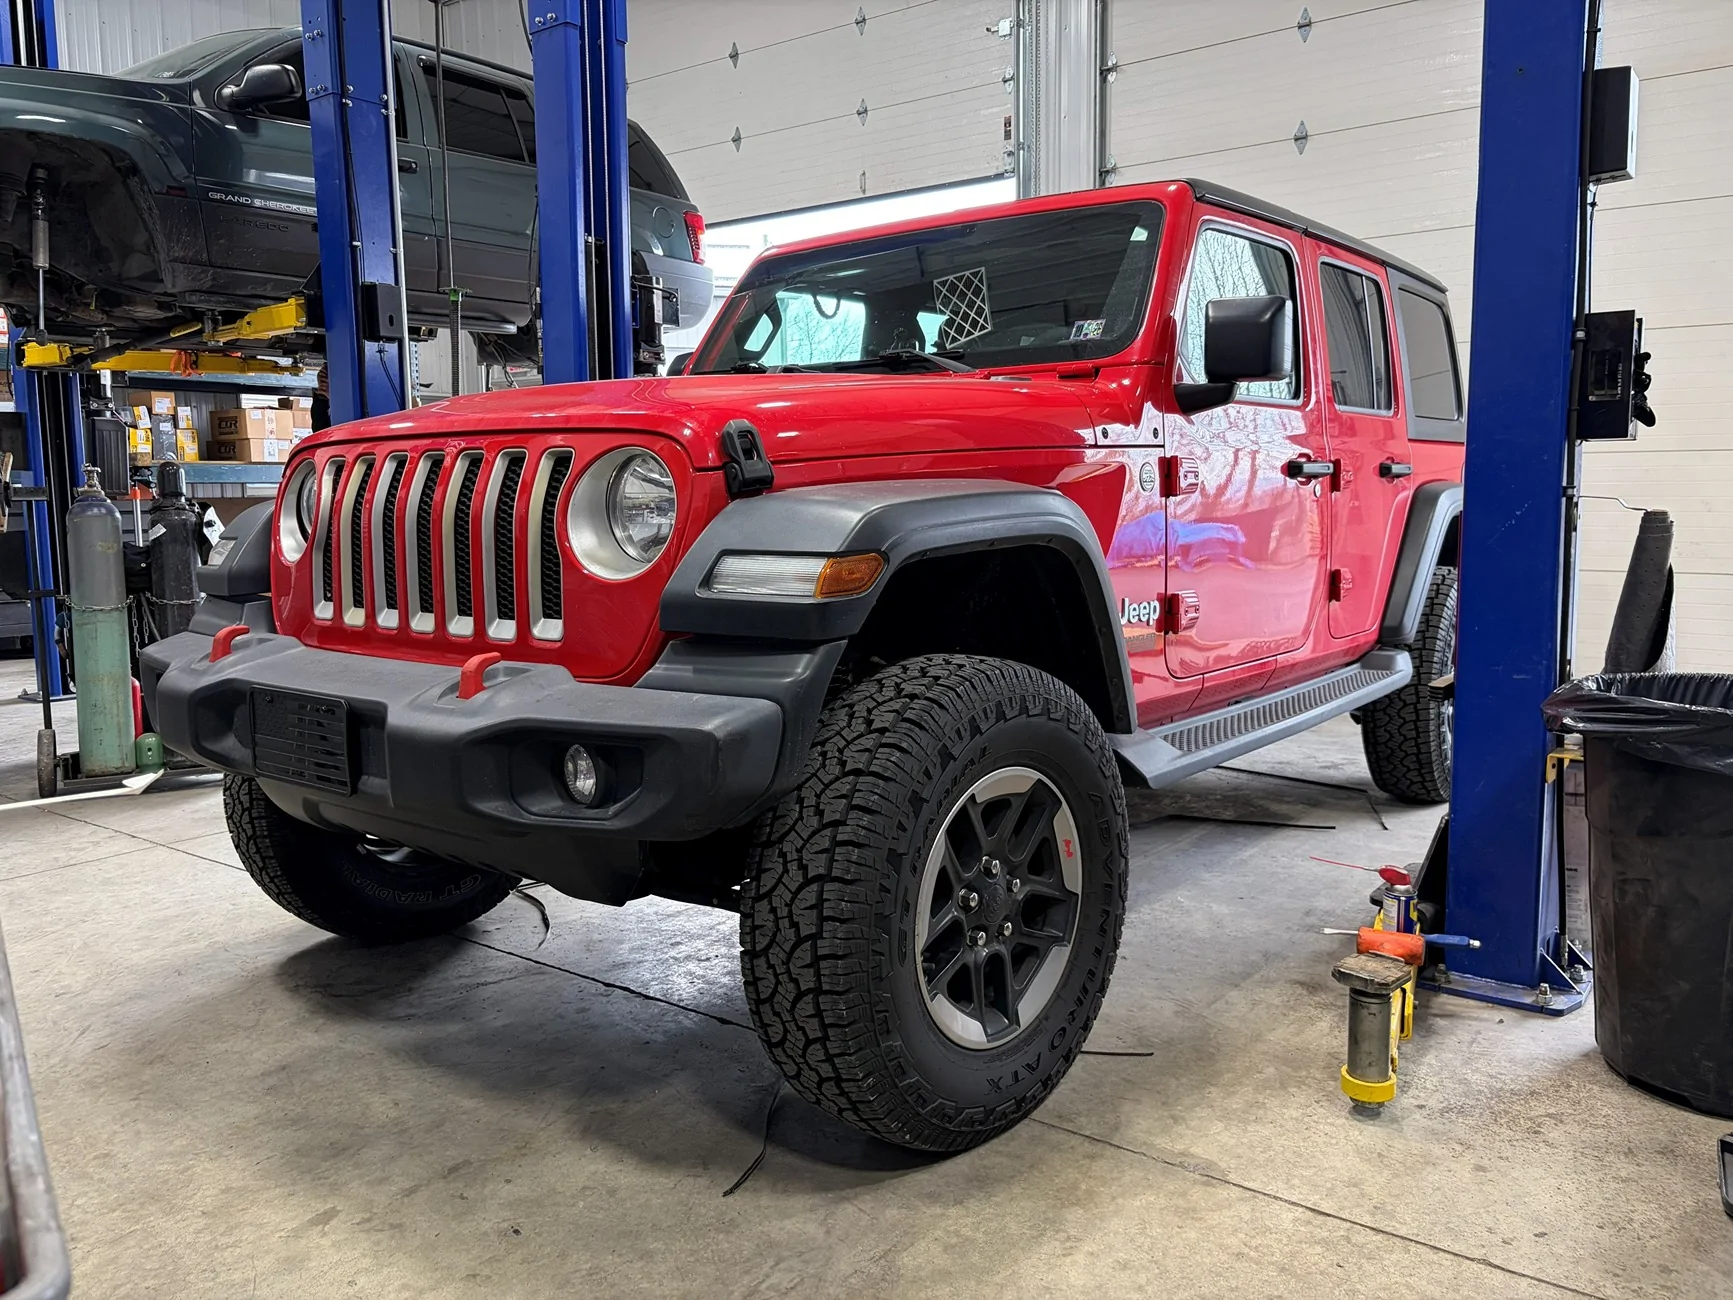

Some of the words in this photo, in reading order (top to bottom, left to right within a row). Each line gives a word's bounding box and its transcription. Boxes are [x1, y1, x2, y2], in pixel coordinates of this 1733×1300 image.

[208, 191, 252, 204] GRAND
[253, 198, 315, 214] CHEROKEE
[220, 215, 289, 232] LAREDO
[1119, 597, 1160, 626] Jeep
[899, 886, 910, 967] GT
[910, 746, 993, 877] RADIAL
[341, 860, 433, 904] RADIAL
[439, 874, 482, 900] GT
[1050, 791, 1113, 1051] ADVENTURO
[984, 1056, 1042, 1095] ATX
